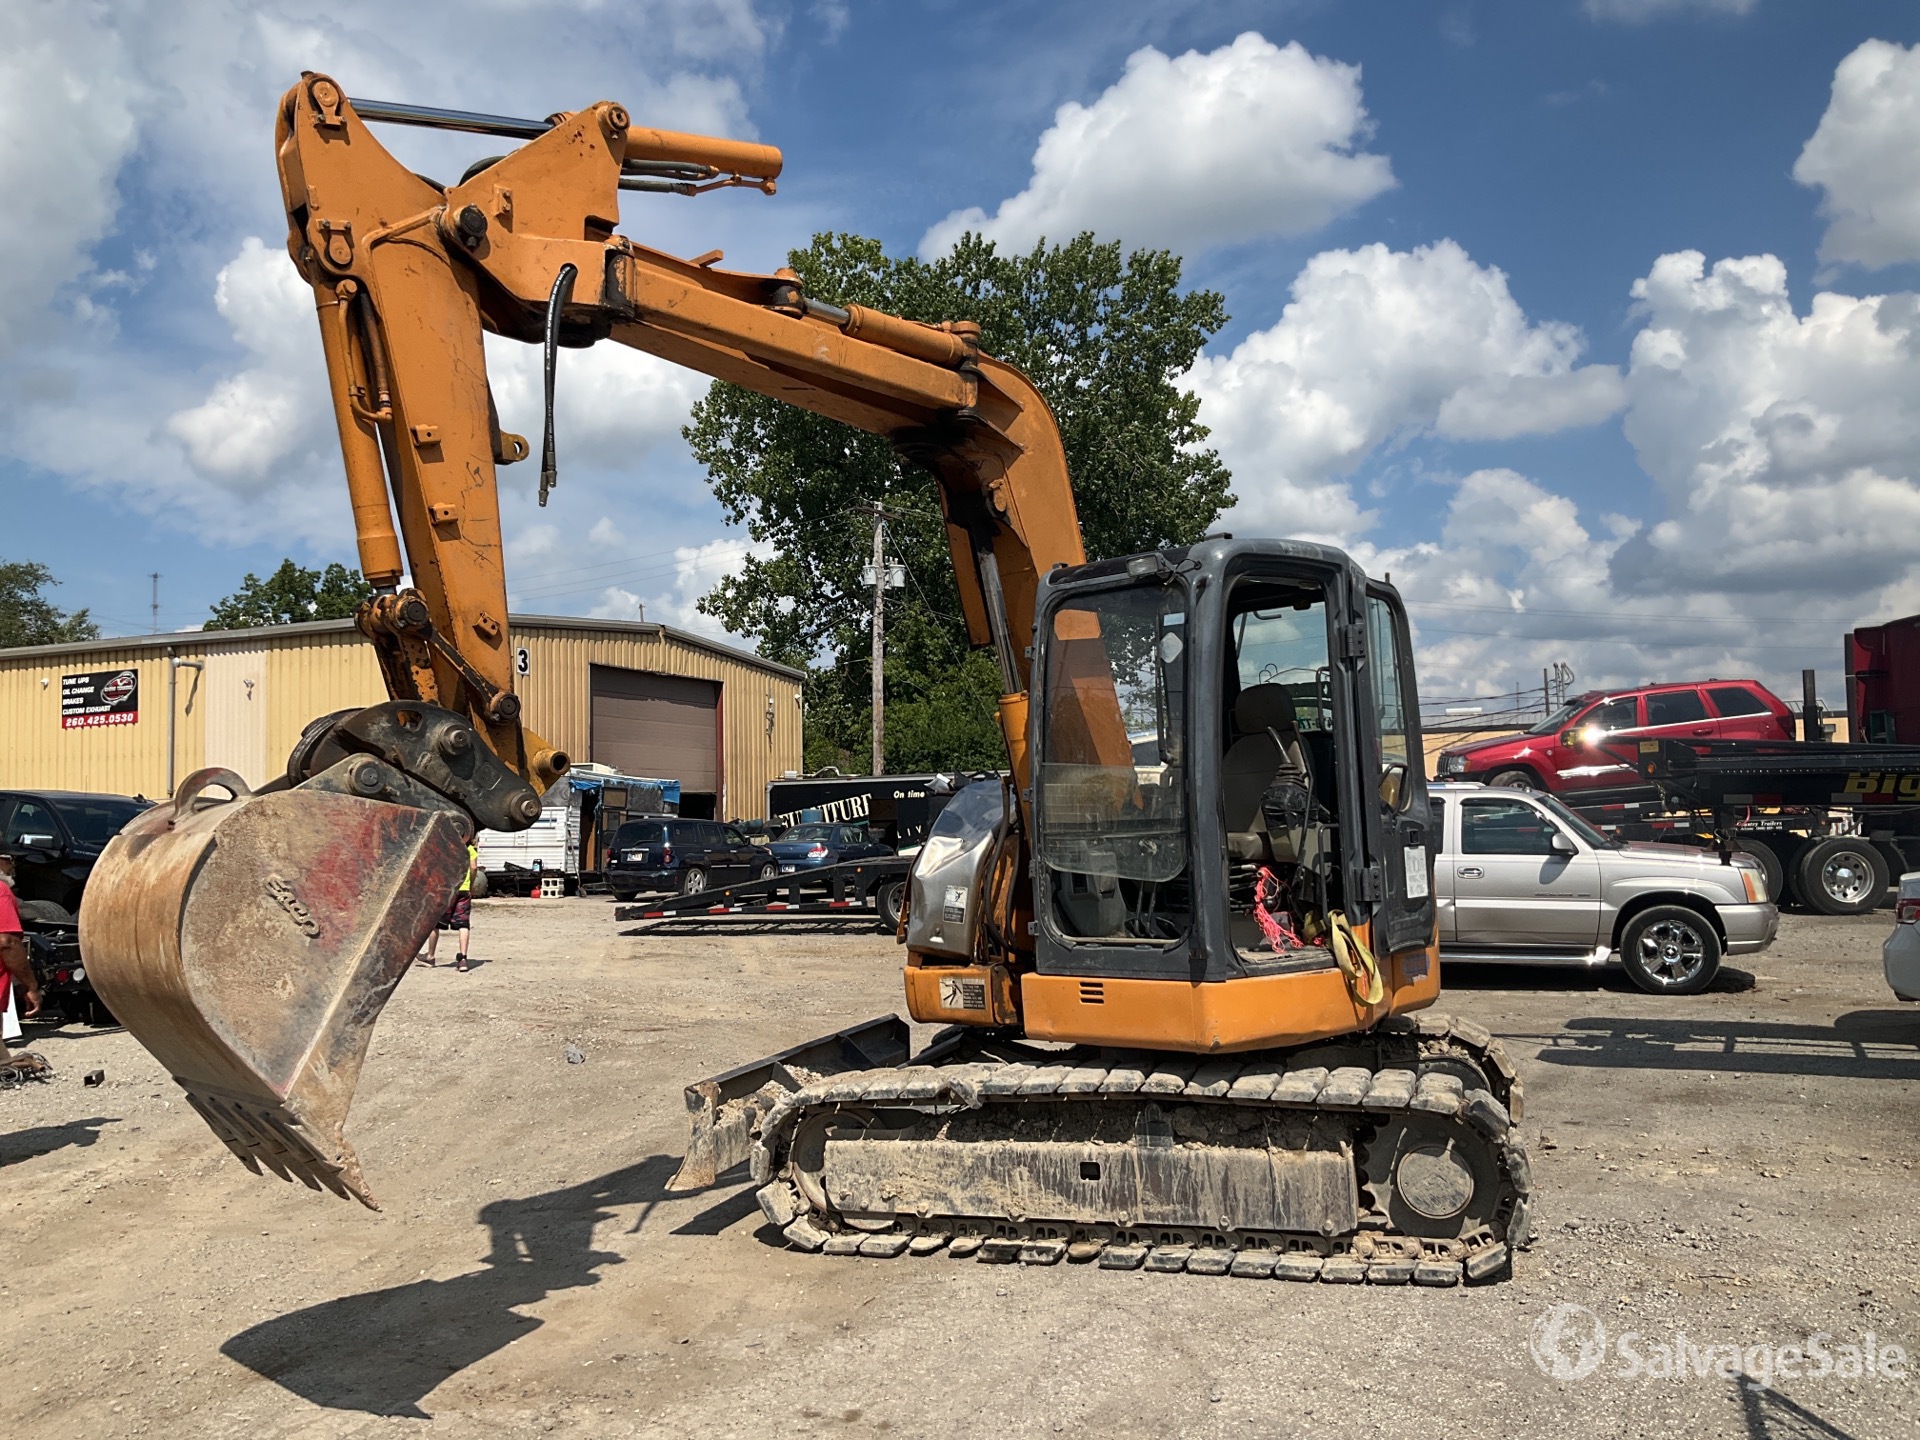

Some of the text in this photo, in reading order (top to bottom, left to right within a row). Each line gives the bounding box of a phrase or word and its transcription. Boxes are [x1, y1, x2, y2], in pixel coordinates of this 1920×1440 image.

[518, 650, 528, 672] 3
[71, 686, 95, 694] CHANGE
[63, 697, 84, 705] BRAKES
[66, 713, 134, 727] 260.425.0530
[894, 790, 926, 799] On time
